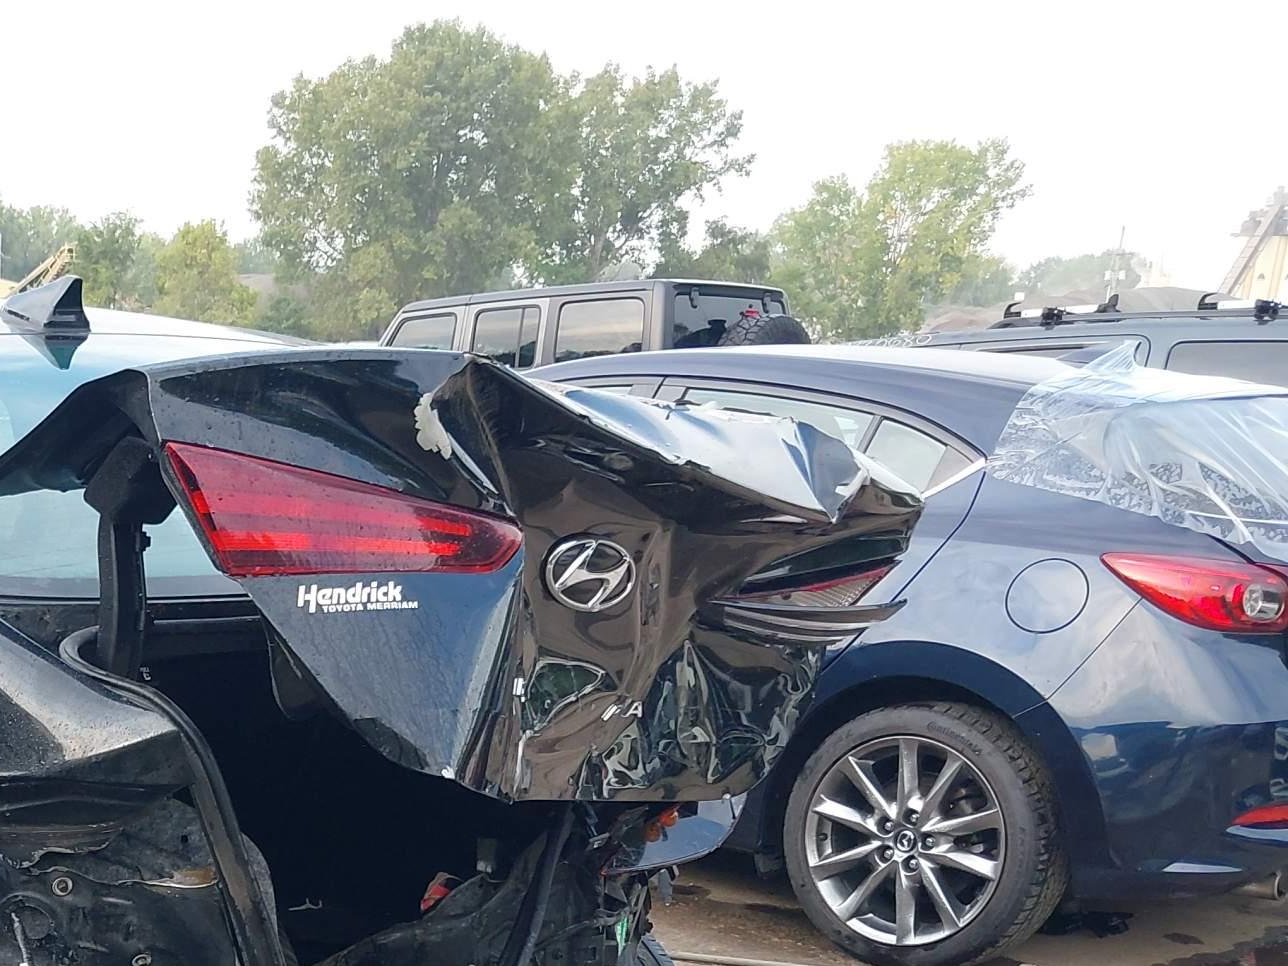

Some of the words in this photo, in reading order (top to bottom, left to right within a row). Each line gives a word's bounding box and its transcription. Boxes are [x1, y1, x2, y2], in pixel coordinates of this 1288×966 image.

[296, 581, 402, 614] Hendrick
[321, 604, 364, 613] TOYOTA
[366, 601, 419, 610] MERRIAM
